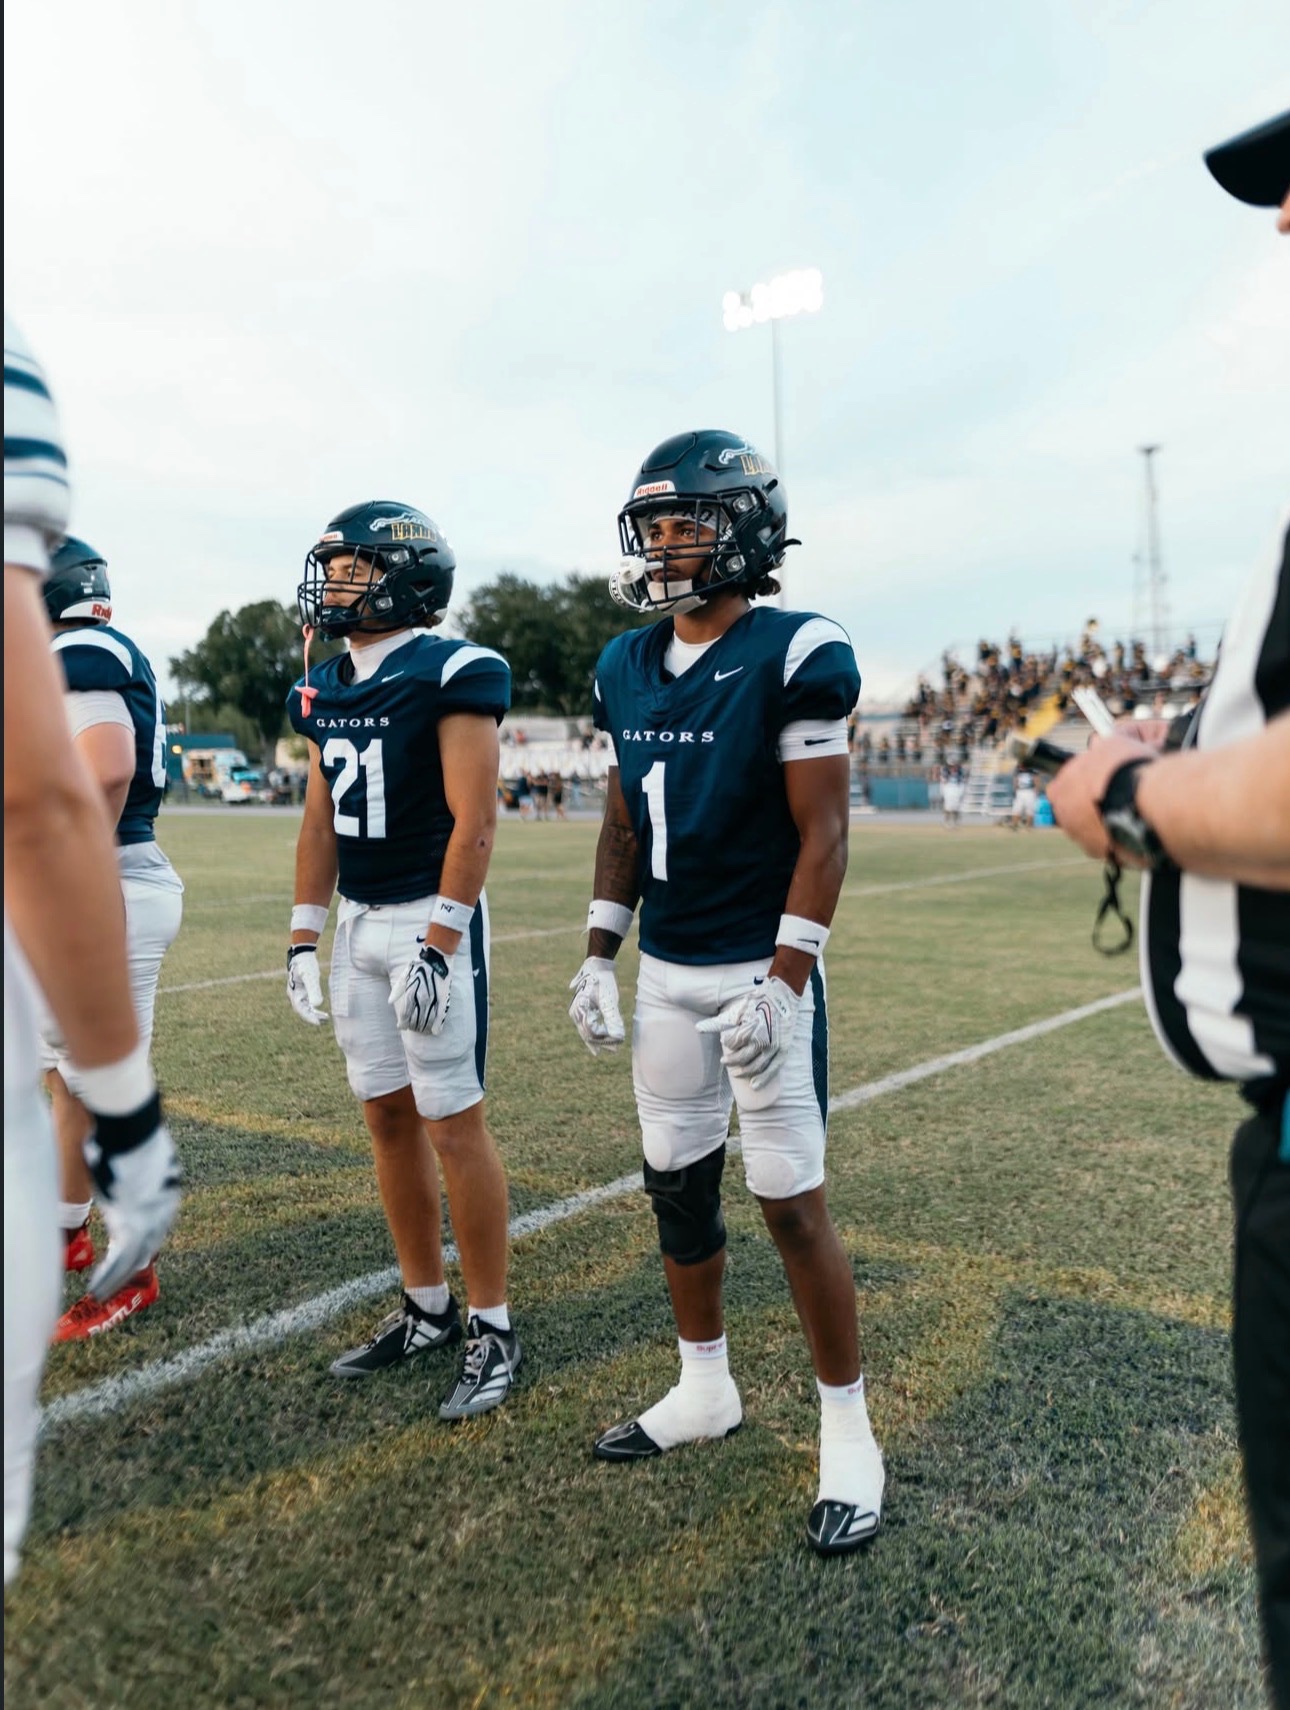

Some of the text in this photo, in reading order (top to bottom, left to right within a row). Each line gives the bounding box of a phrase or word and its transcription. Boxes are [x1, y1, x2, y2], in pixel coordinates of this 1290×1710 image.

[316, 717, 390, 728] GATORS
[622, 729, 715, 743] GATORS
[322, 738, 387, 838] 21
[641, 761, 668, 882] 1
